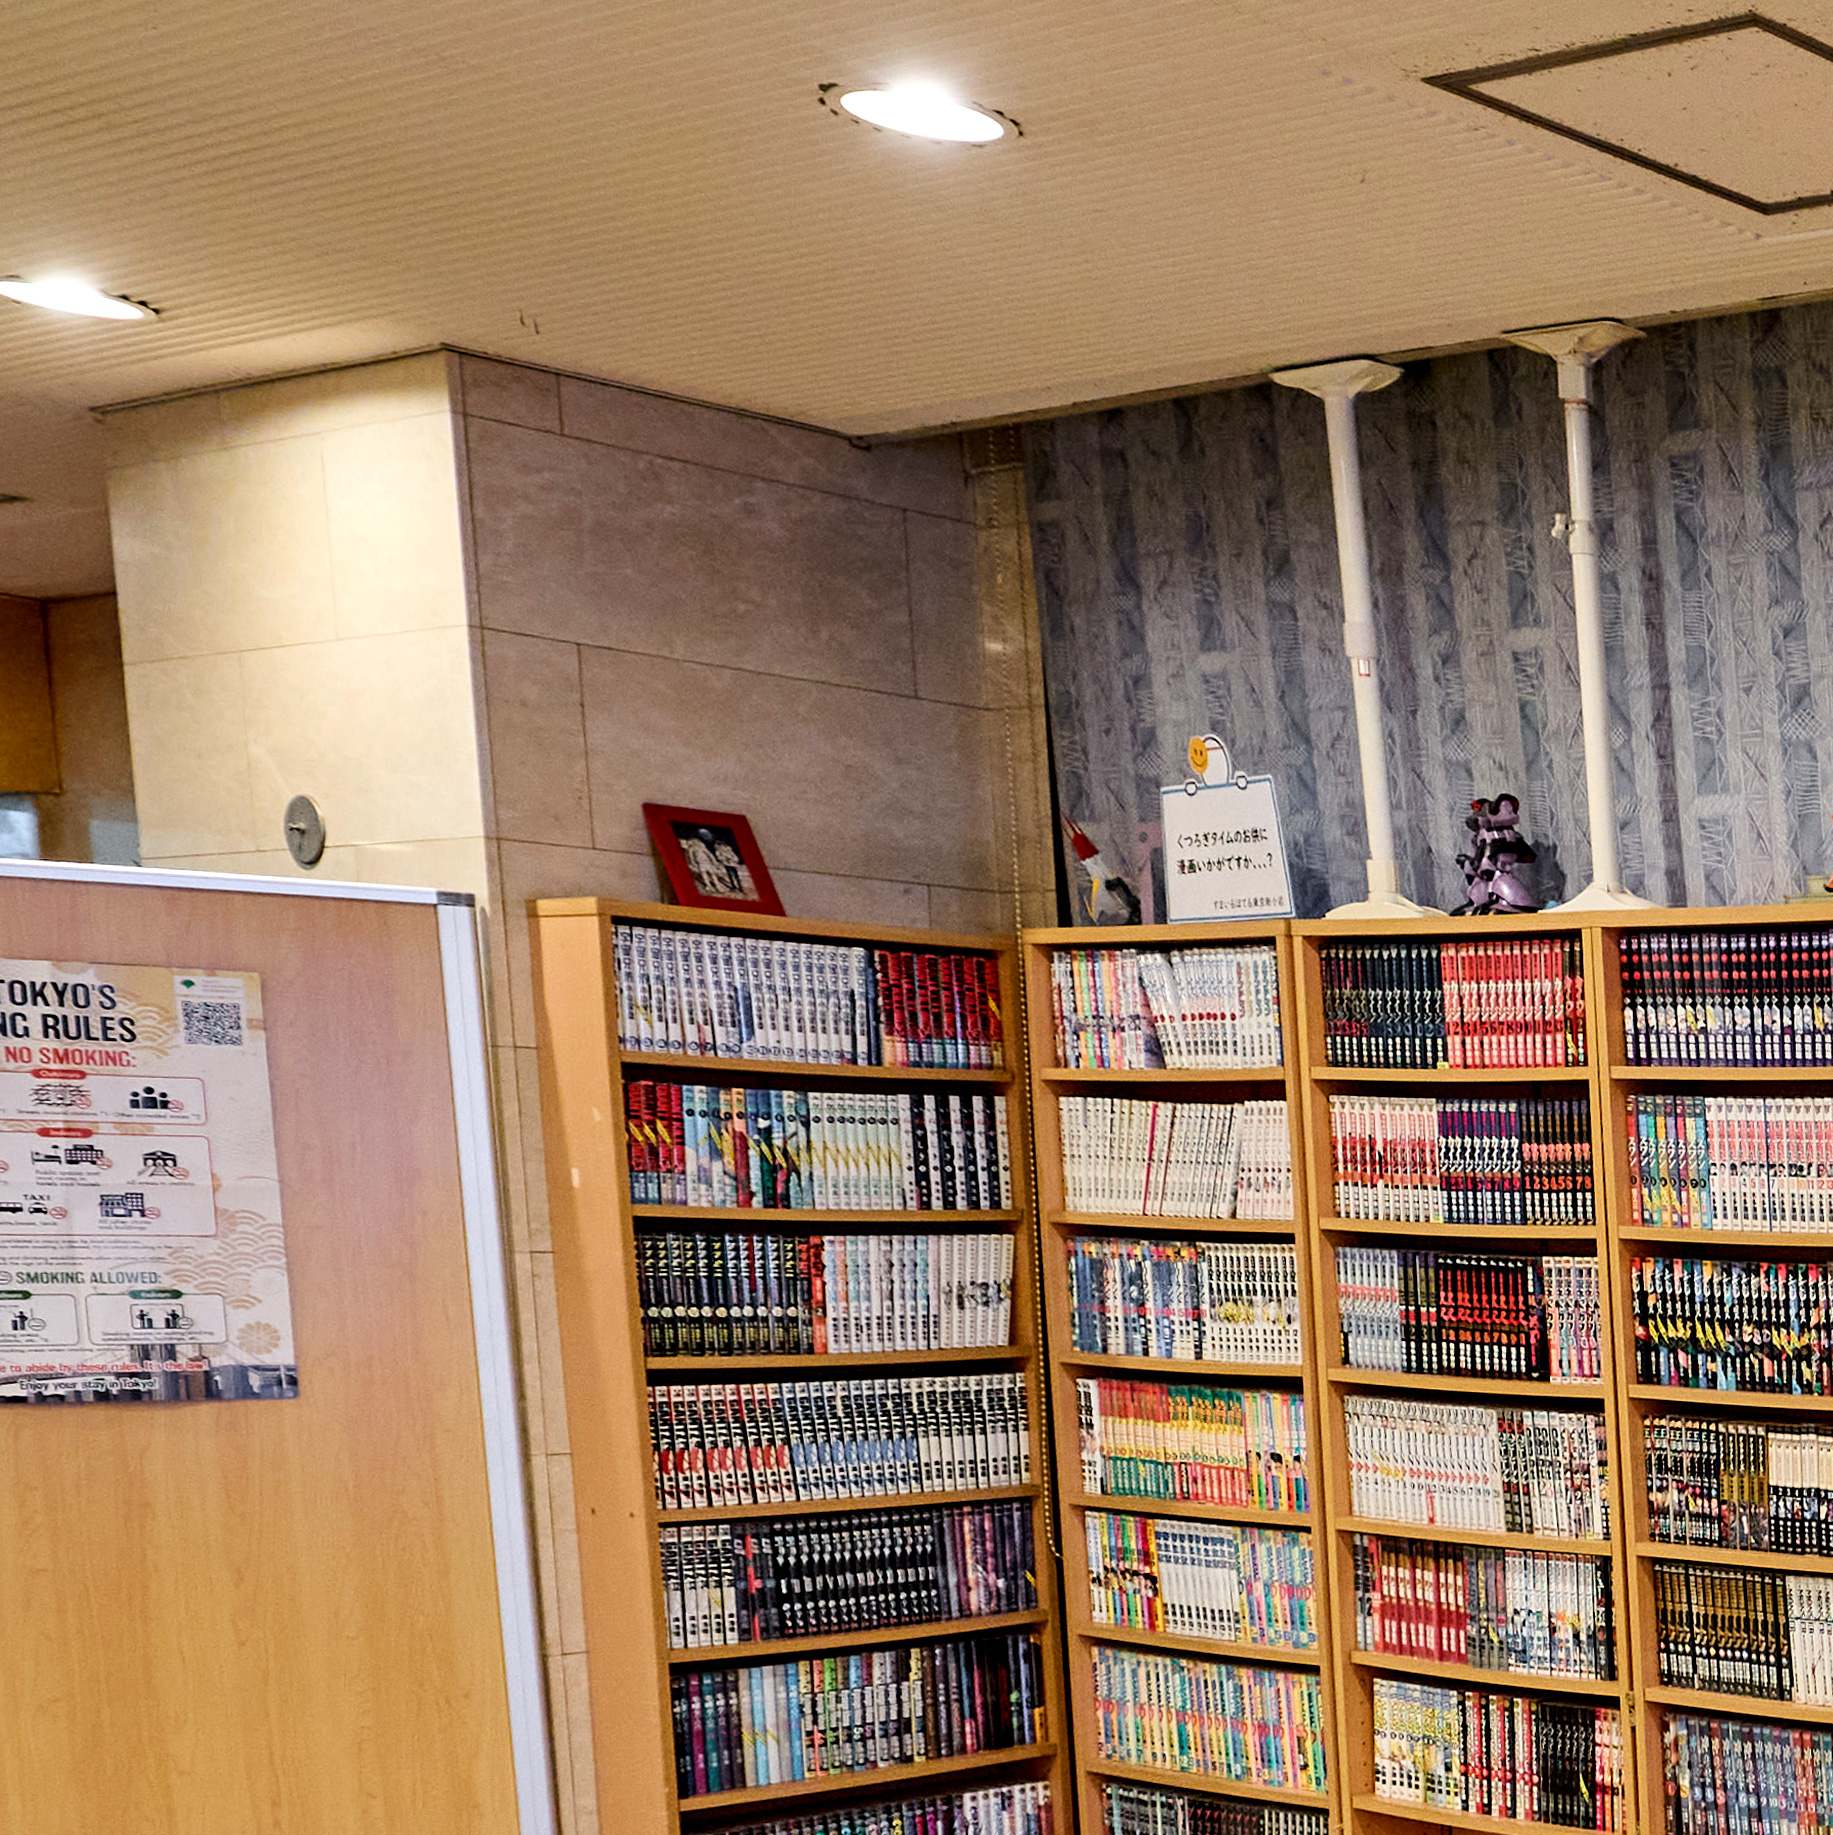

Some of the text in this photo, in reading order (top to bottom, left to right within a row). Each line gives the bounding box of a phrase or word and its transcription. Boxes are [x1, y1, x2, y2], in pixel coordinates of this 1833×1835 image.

[41, 1013, 137, 1042] RULES
[5, 1046, 137, 1067] NO SMOKING:
[15, 1271, 162, 1285] SMOKING ALLOWED:
[20, 1378, 157, 1392] Enjoy your stay in Tokyo!
